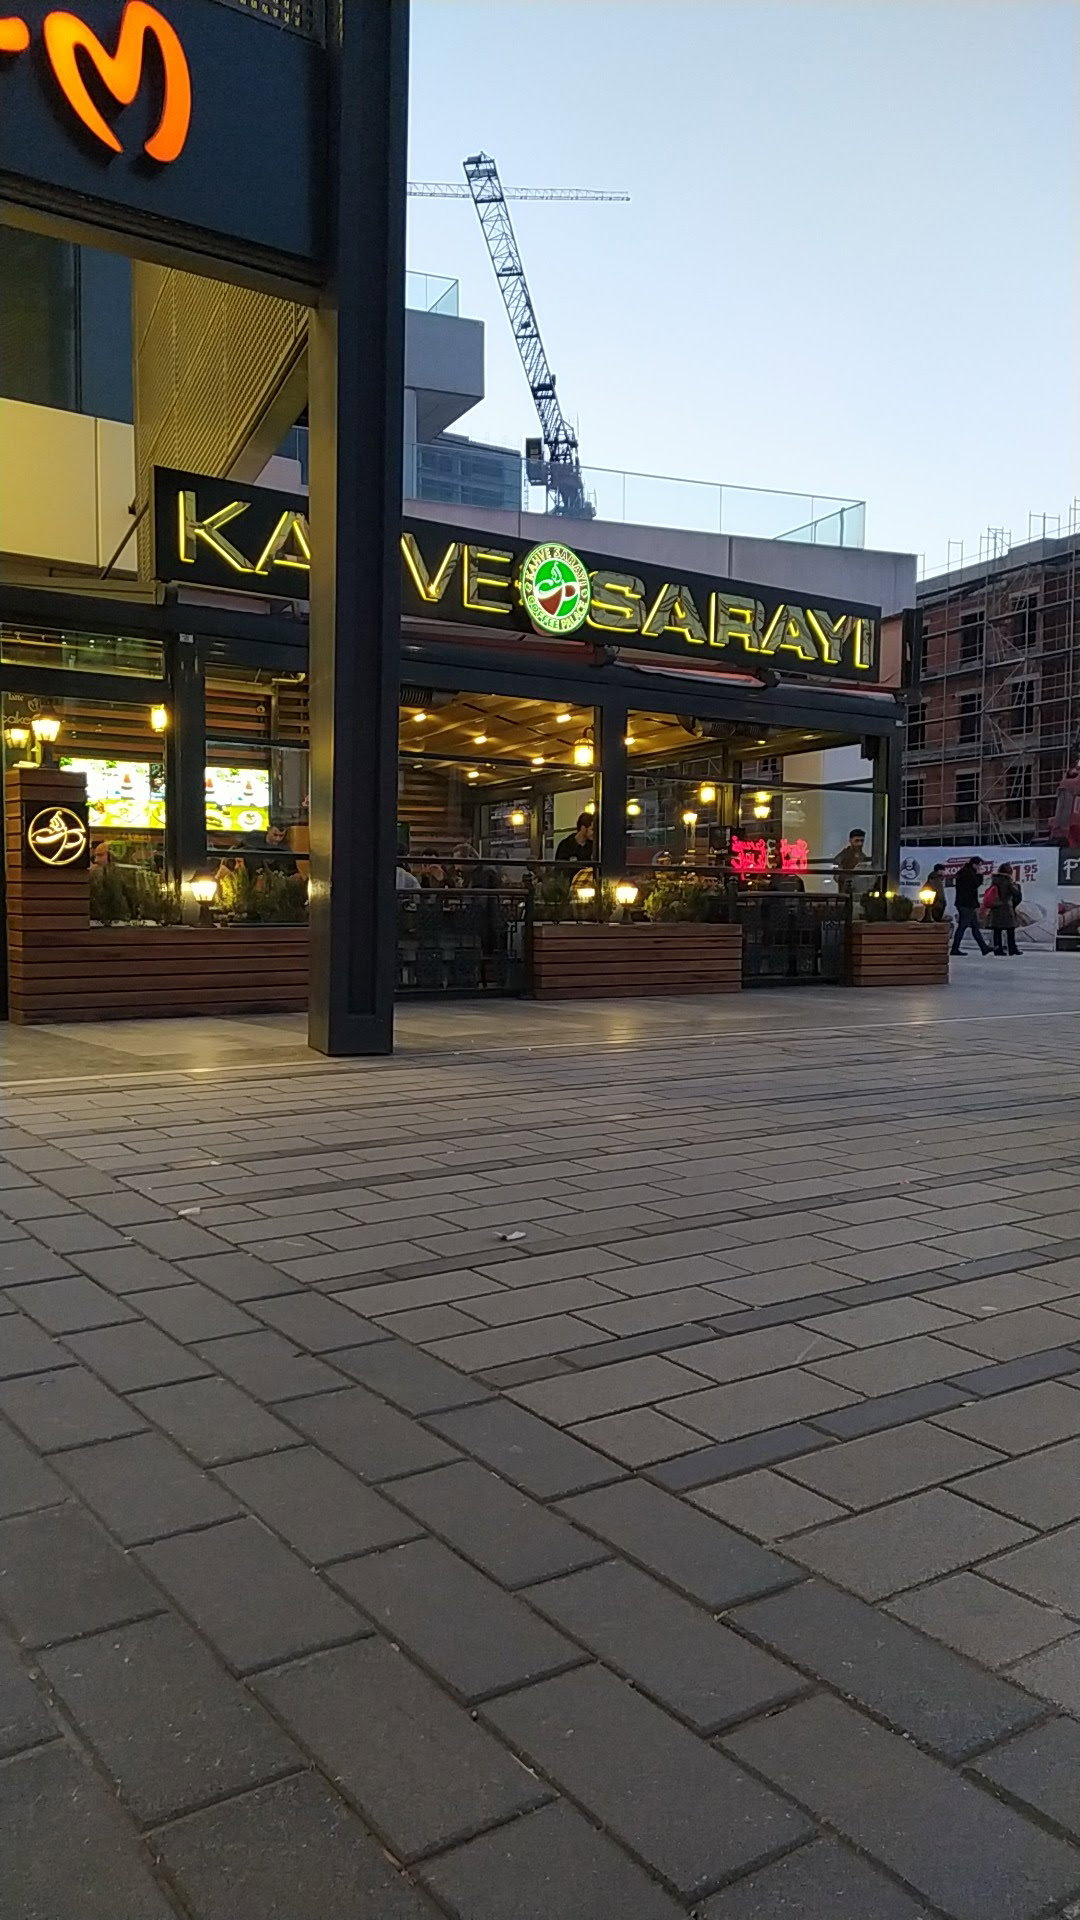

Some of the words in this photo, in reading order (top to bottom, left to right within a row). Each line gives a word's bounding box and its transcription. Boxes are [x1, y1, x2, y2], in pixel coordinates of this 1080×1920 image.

[525, 547, 552, 582] KAHVE
[553, 547, 588, 586] SARAYI
[527, 594, 559, 630] COFFEE
[586, 570, 876, 669] SARAYI
